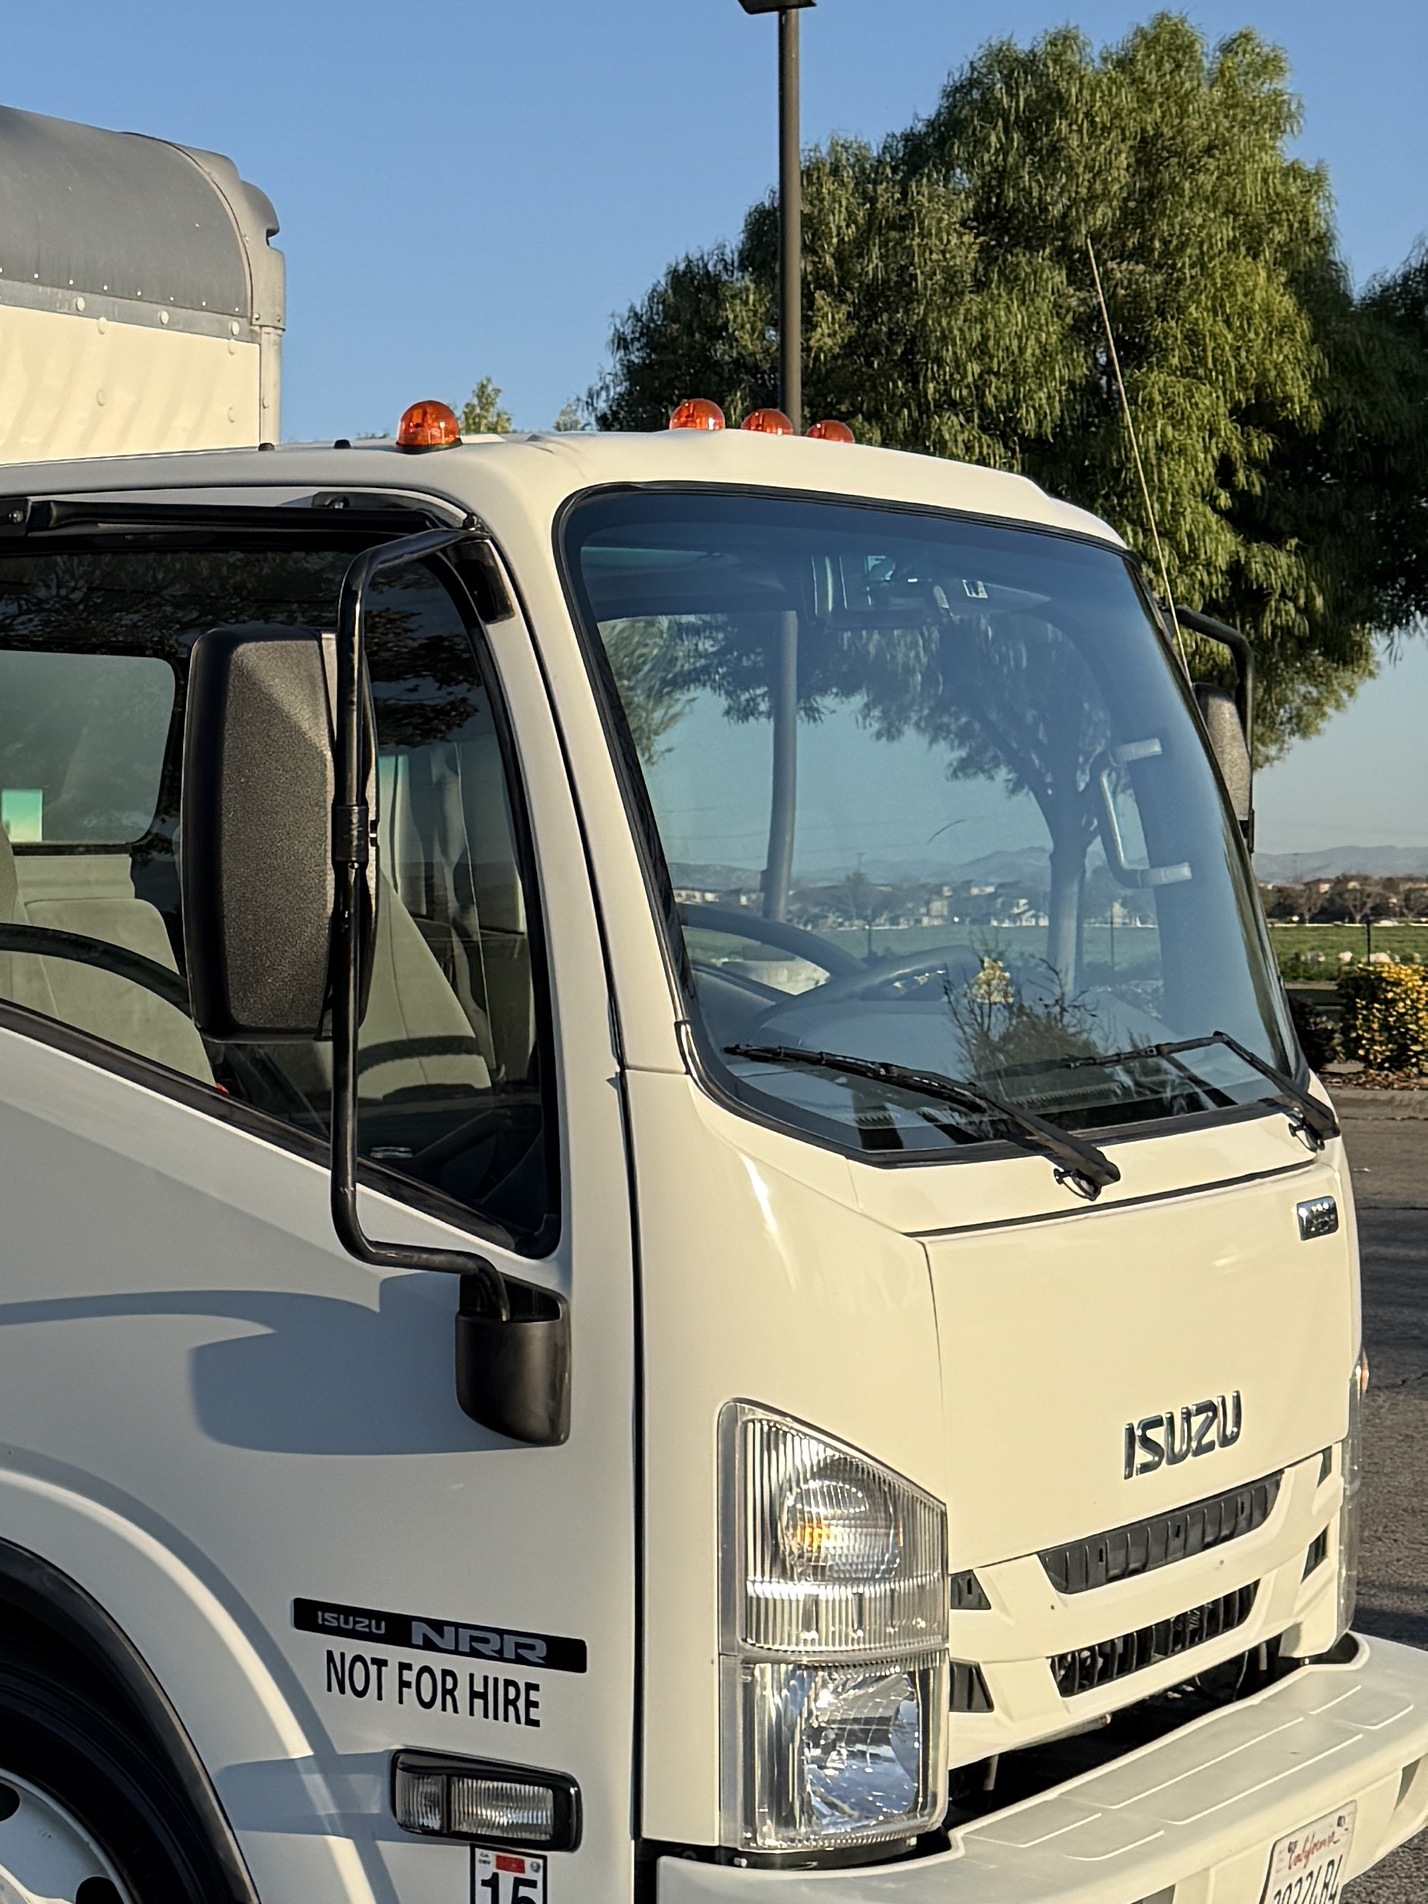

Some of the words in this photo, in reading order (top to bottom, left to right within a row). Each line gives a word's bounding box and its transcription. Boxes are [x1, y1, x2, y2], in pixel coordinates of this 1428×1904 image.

[1124, 1390, 1241, 1480] ISUZU
[317, 1610, 386, 1634] ISUZU
[411, 1621, 547, 1664] NRR
[326, 1649, 389, 1701] NOT
[398, 1660, 459, 1715] FOR
[469, 1672, 541, 1728] HIRE
